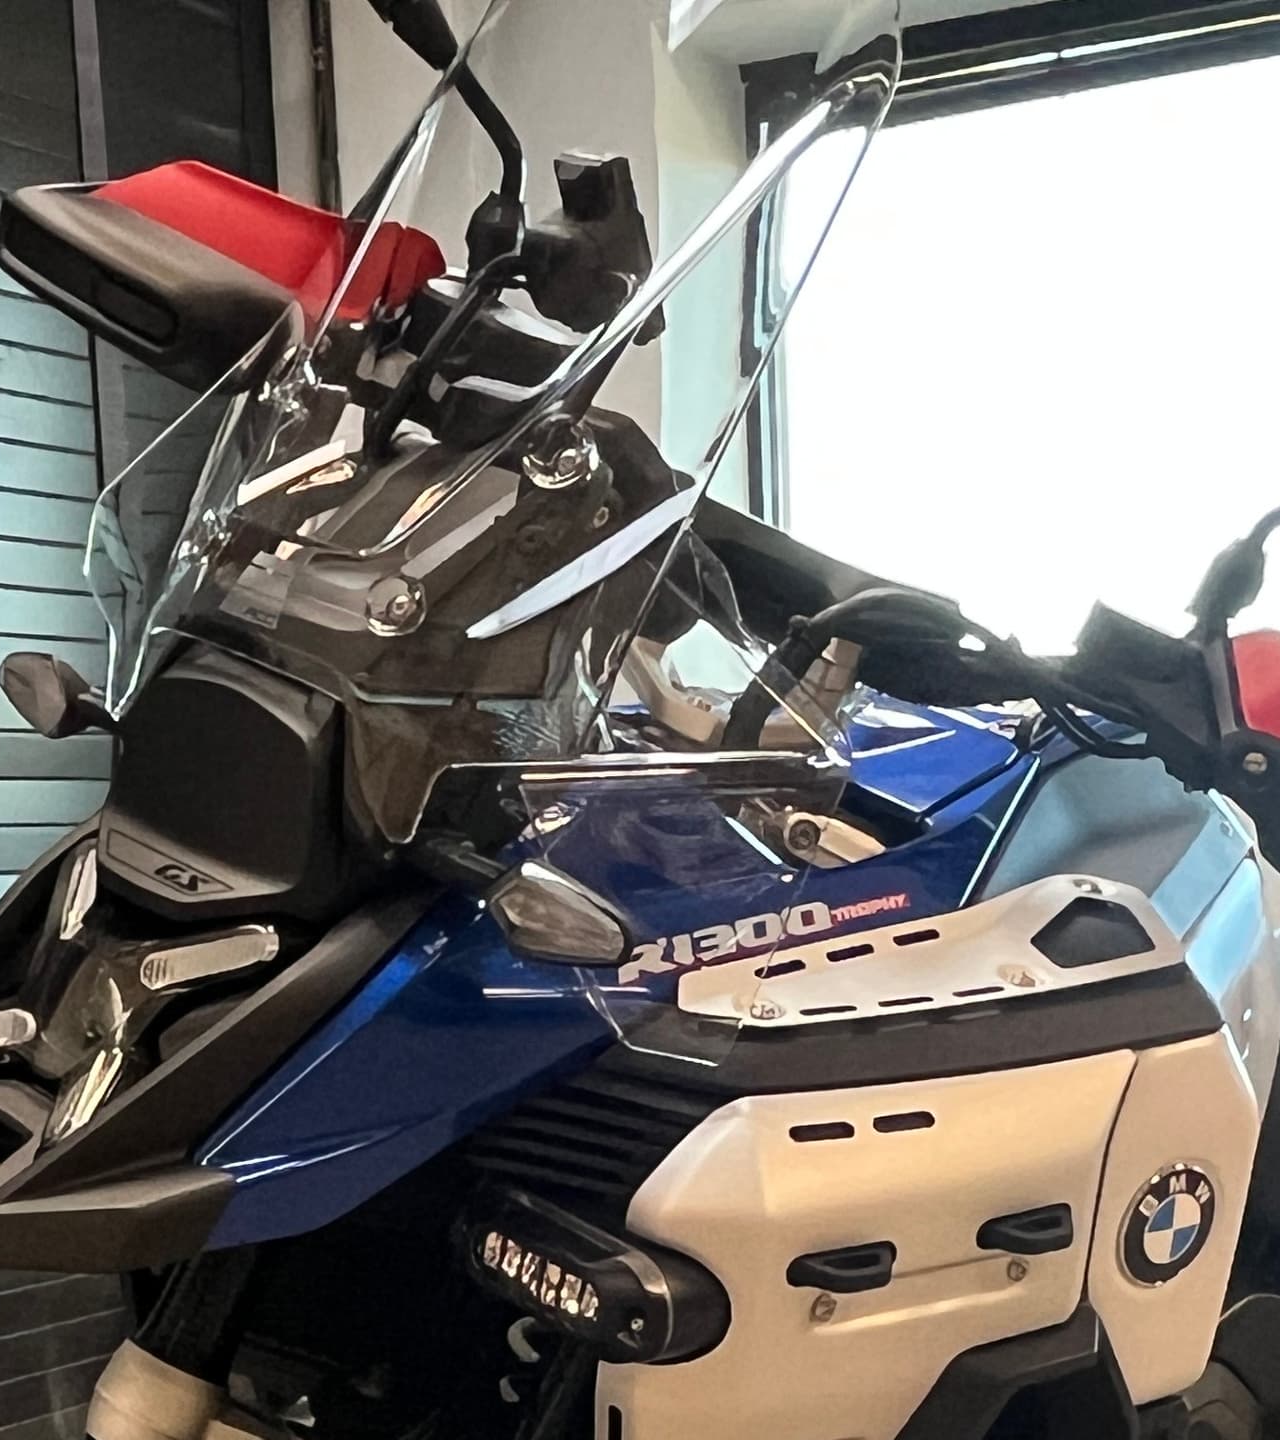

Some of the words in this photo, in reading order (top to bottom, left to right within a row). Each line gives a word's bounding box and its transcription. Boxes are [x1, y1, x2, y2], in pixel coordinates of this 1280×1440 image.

[154, 864, 210, 891] GS
[618, 901, 832, 985] R1300
[830, 893, 907, 921] TROPHY
[1138, 1173, 1210, 1217] BMW
